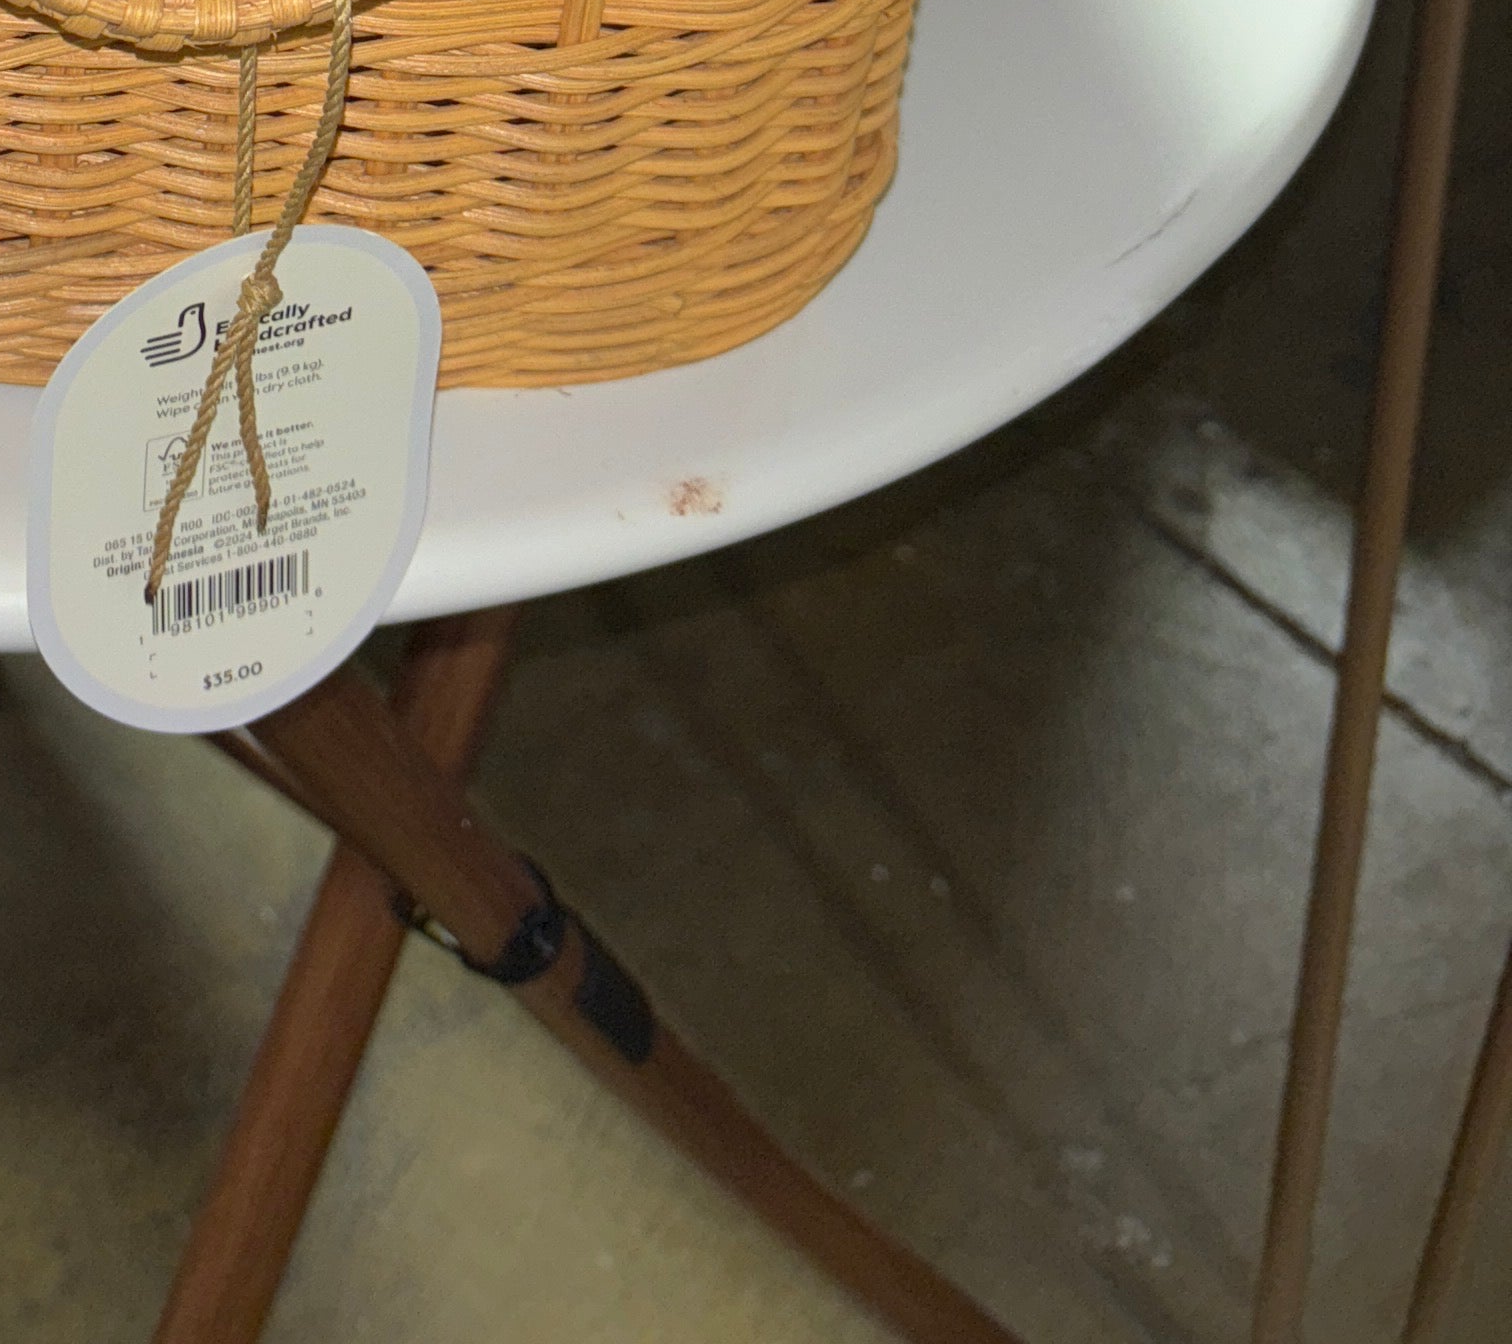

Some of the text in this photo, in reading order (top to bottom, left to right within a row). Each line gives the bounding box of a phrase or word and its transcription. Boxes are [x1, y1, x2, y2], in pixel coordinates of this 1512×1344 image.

[214, 307, 353, 352] Hdcrafted
[216, 303, 310, 335] Ecally
[156, 406, 195, 419] Wipe
[262, 382, 284, 394] dry
[211, 442, 229, 452] We
[121, 551, 134, 562] by
[311, 499, 329, 511] MN
[171, 611, 224, 637] 98101
[237, 595, 289, 618] 99901
[203, 661, 263, 690] $35.00
